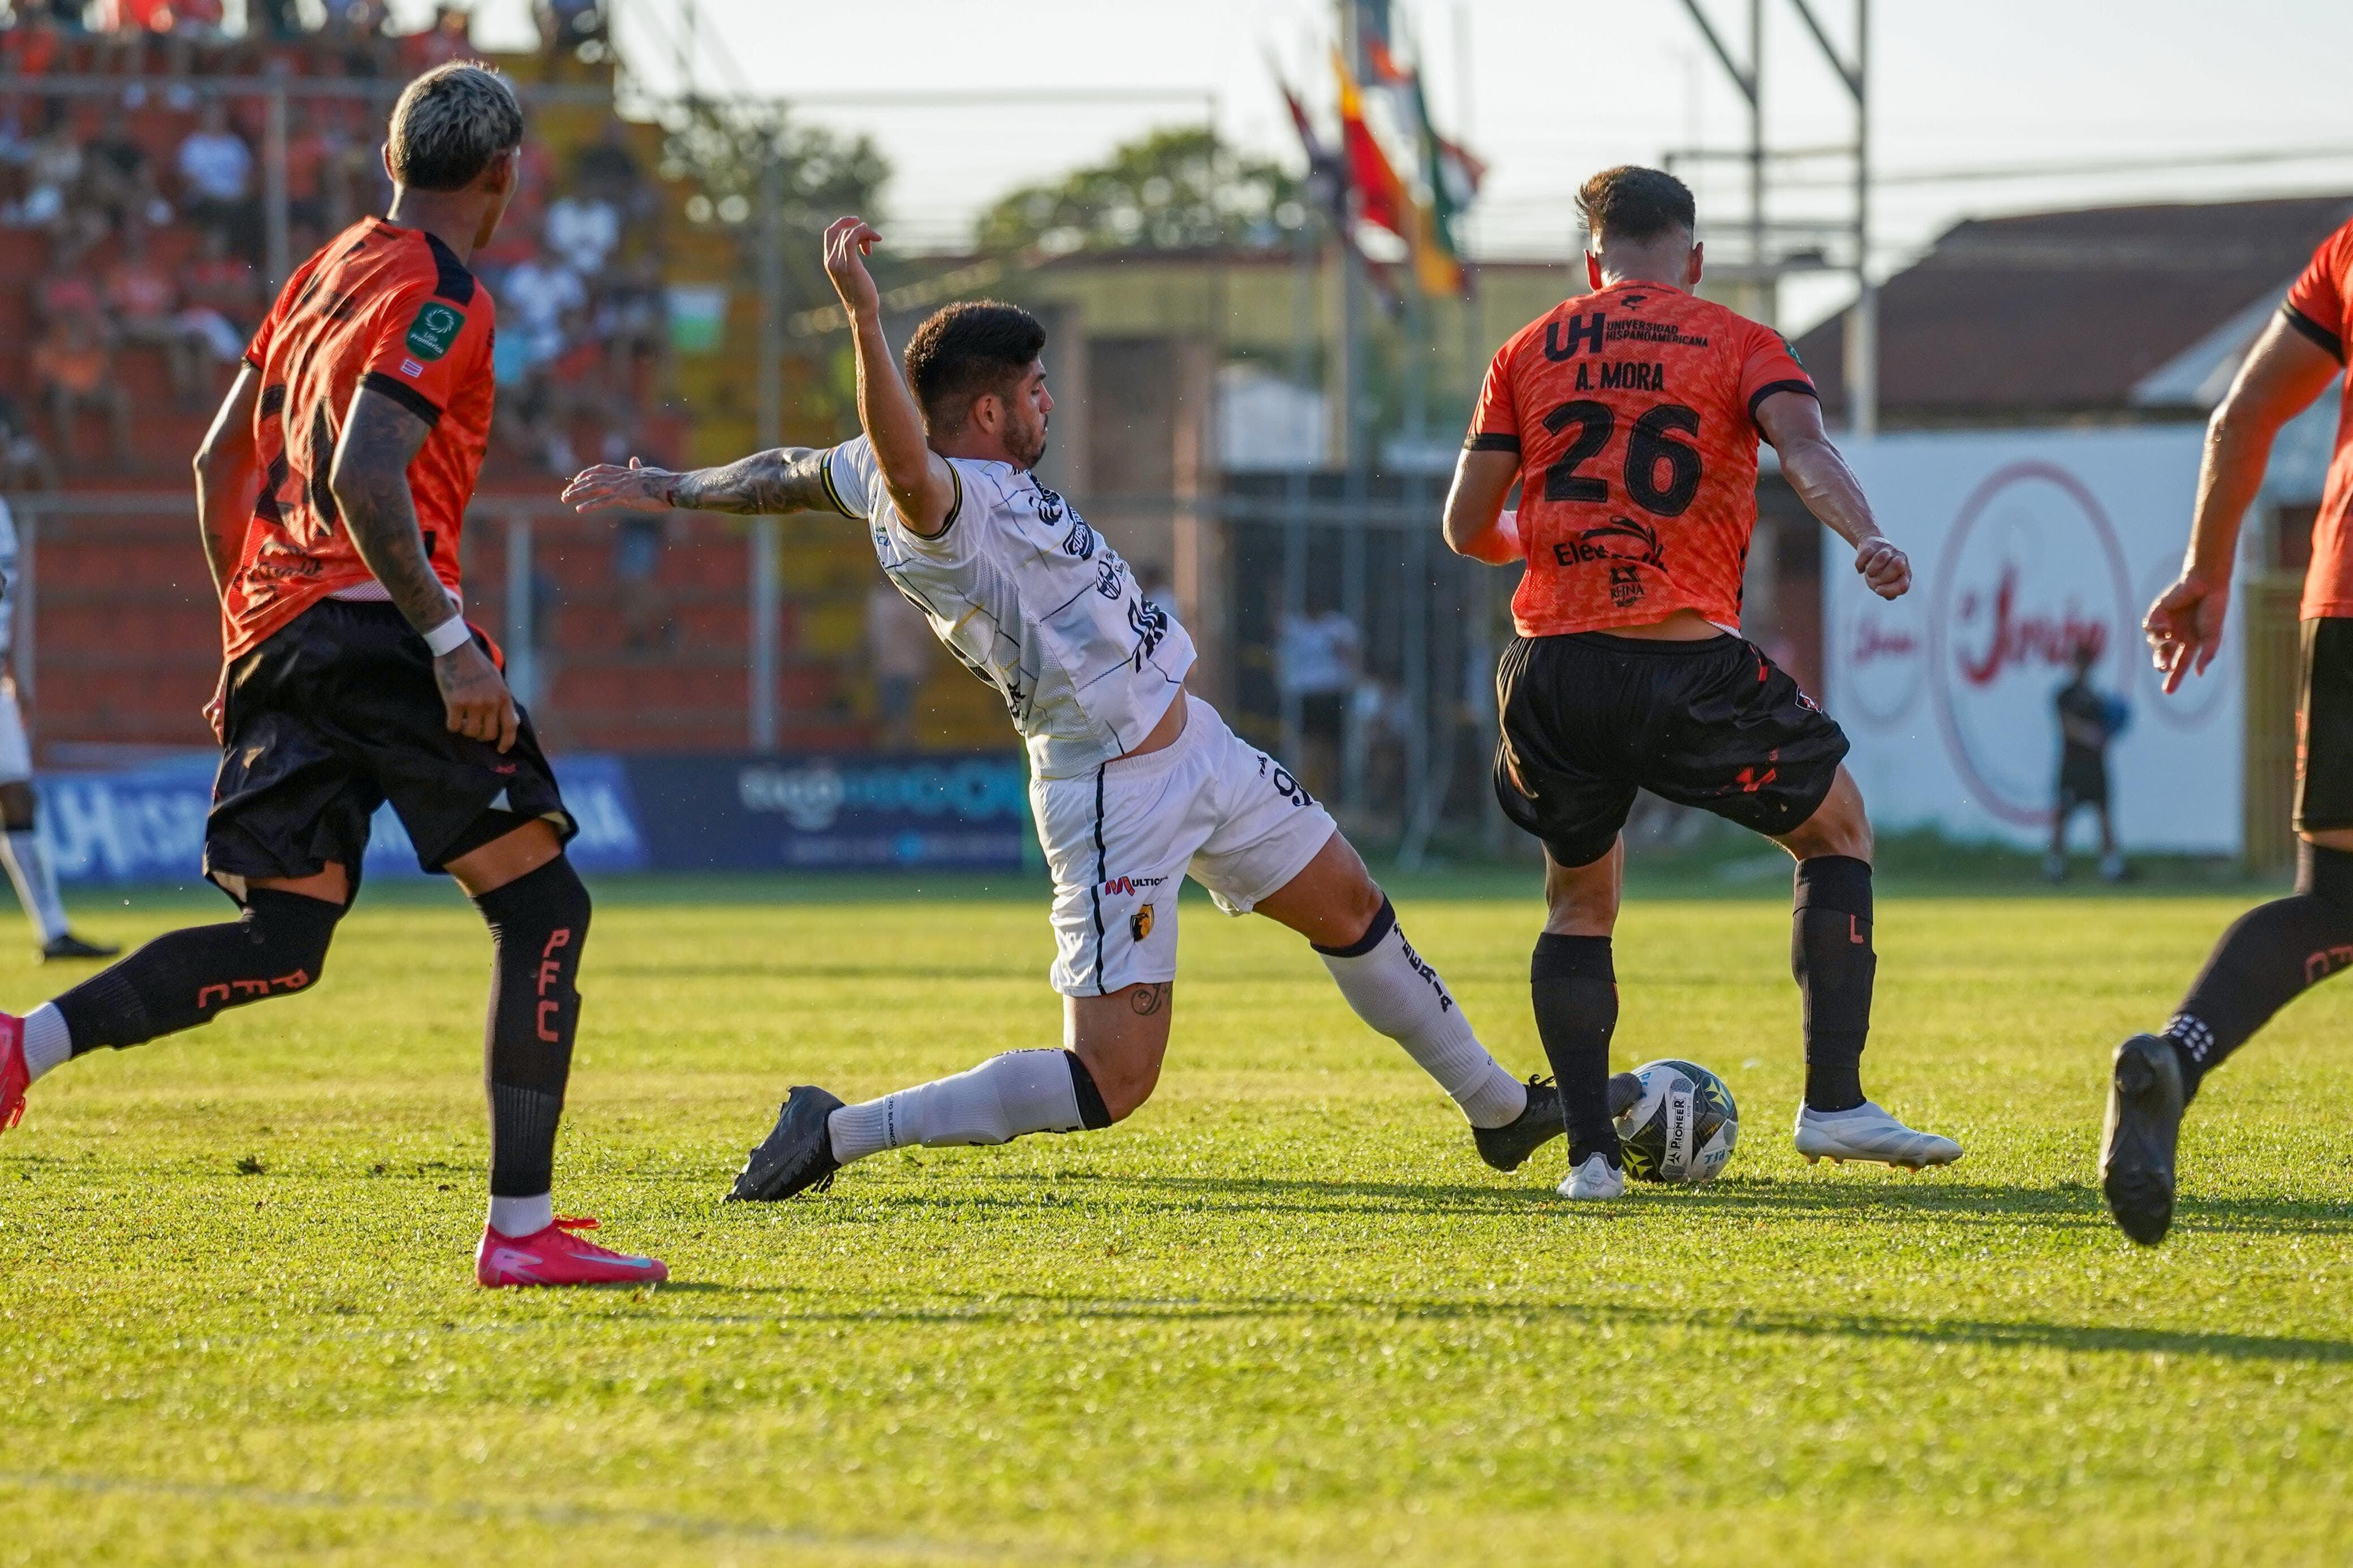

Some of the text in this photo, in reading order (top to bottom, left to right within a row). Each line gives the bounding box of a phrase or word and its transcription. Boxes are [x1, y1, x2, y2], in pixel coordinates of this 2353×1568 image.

[1545, 313, 1606, 362] UH
[1606, 320, 1678, 334] UNIVERSIDAD
[1606, 331, 1708, 348] HISPANOAMERICANA
[1575, 361, 1664, 391] A. MORA
[1542, 399, 1702, 517] 26
[538, 927, 571, 1042] PFC
[888, 1112, 897, 1147] BLANCO
[1669, 1097, 1686, 1151] PIONEER
